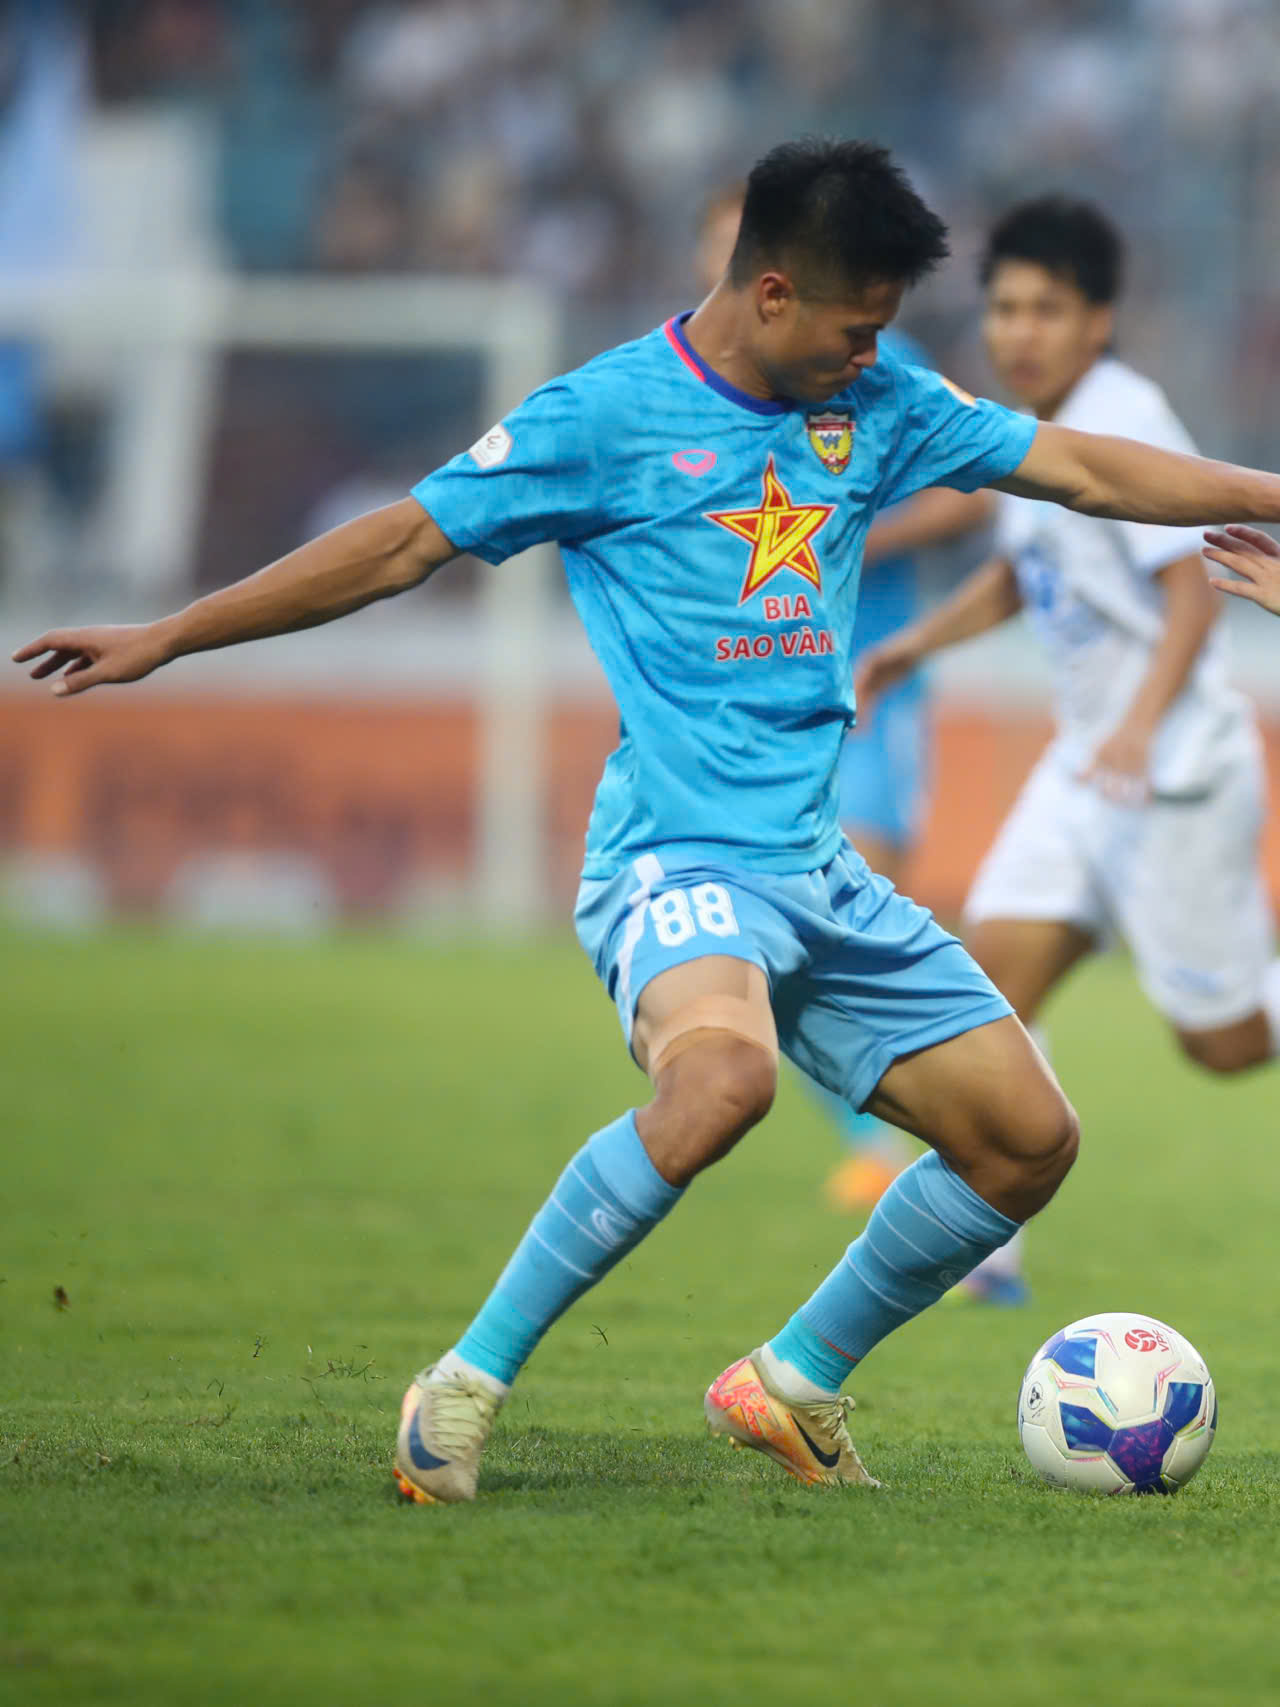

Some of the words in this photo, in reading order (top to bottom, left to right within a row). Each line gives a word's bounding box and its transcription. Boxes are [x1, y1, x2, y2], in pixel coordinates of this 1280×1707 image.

[762, 593, 813, 621] BIA
[715, 633, 775, 661] SAO
[779, 625, 834, 656] VÀN
[649, 882, 740, 947] 88
